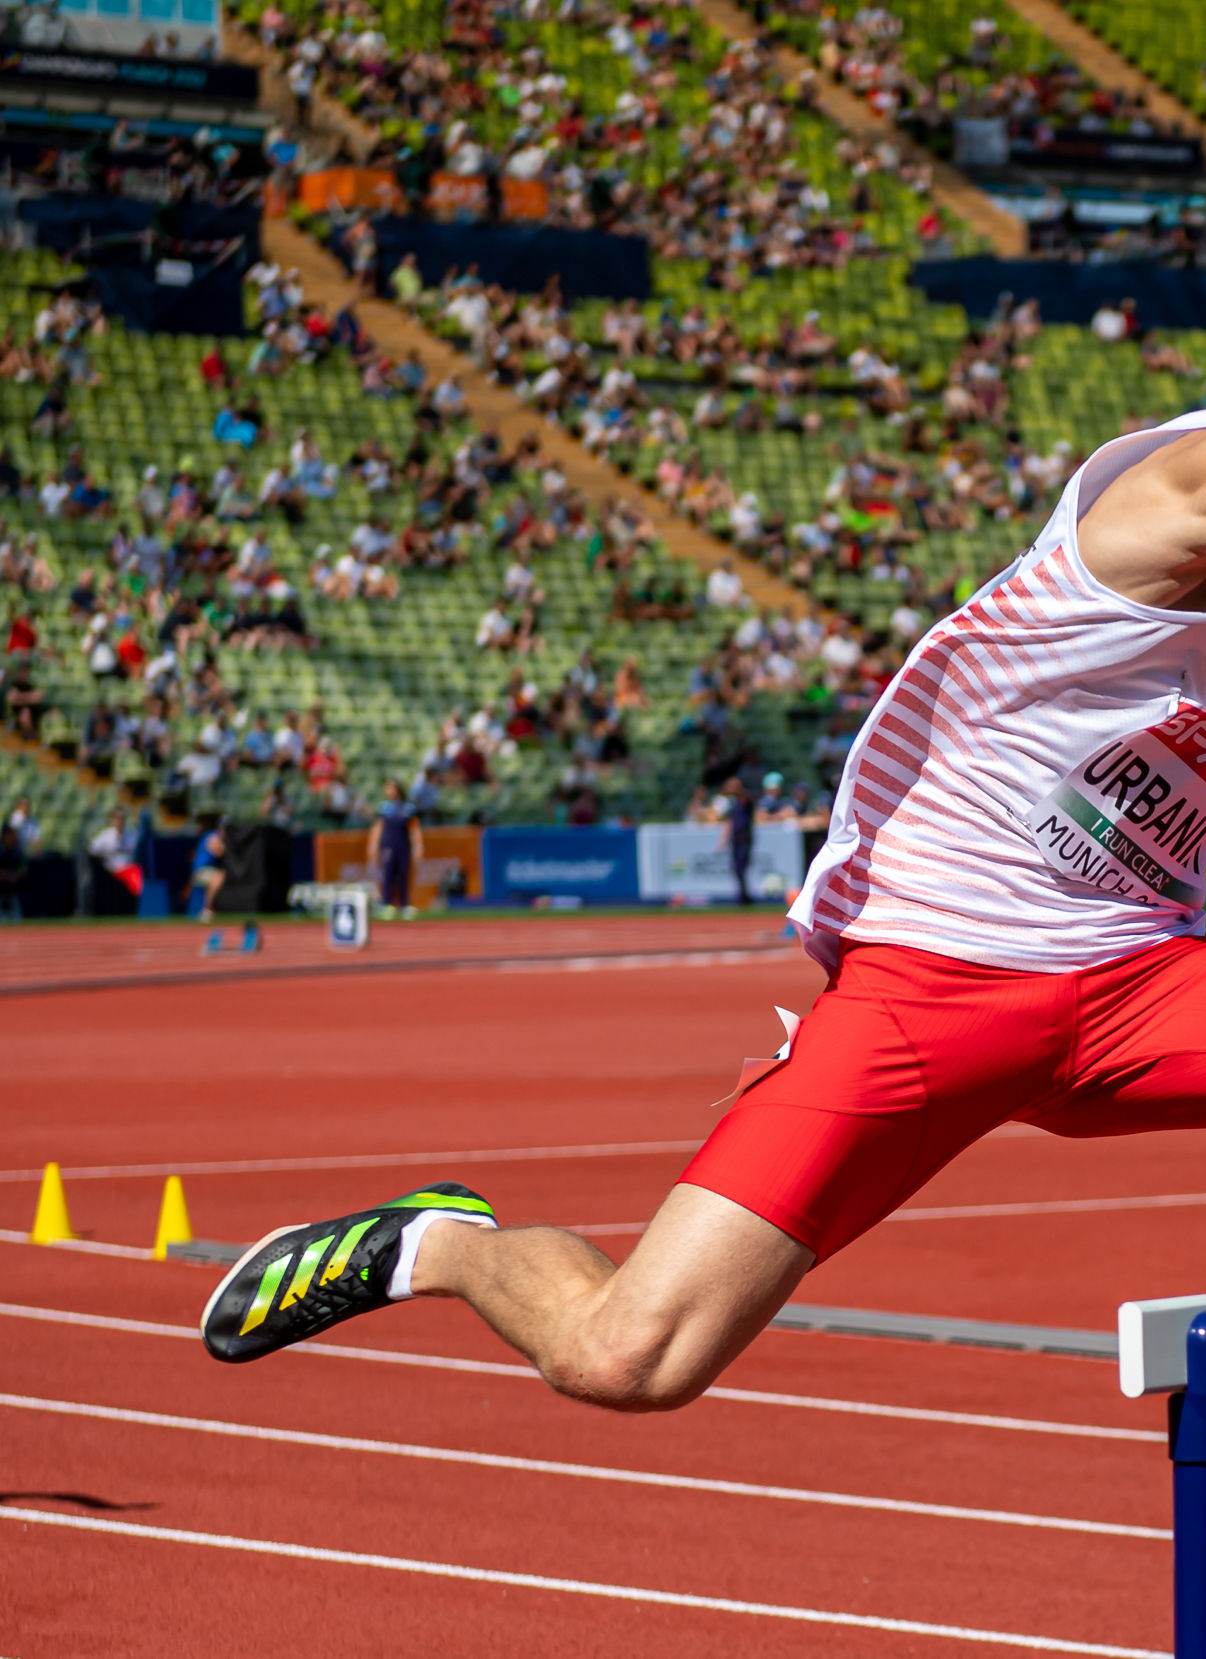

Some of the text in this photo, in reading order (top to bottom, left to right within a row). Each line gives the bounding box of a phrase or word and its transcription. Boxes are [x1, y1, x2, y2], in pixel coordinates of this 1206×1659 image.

[1035, 815, 1134, 895] MUNICH
[1098, 825, 1135, 861] RUN
[1131, 853, 1170, 892] CLEA
